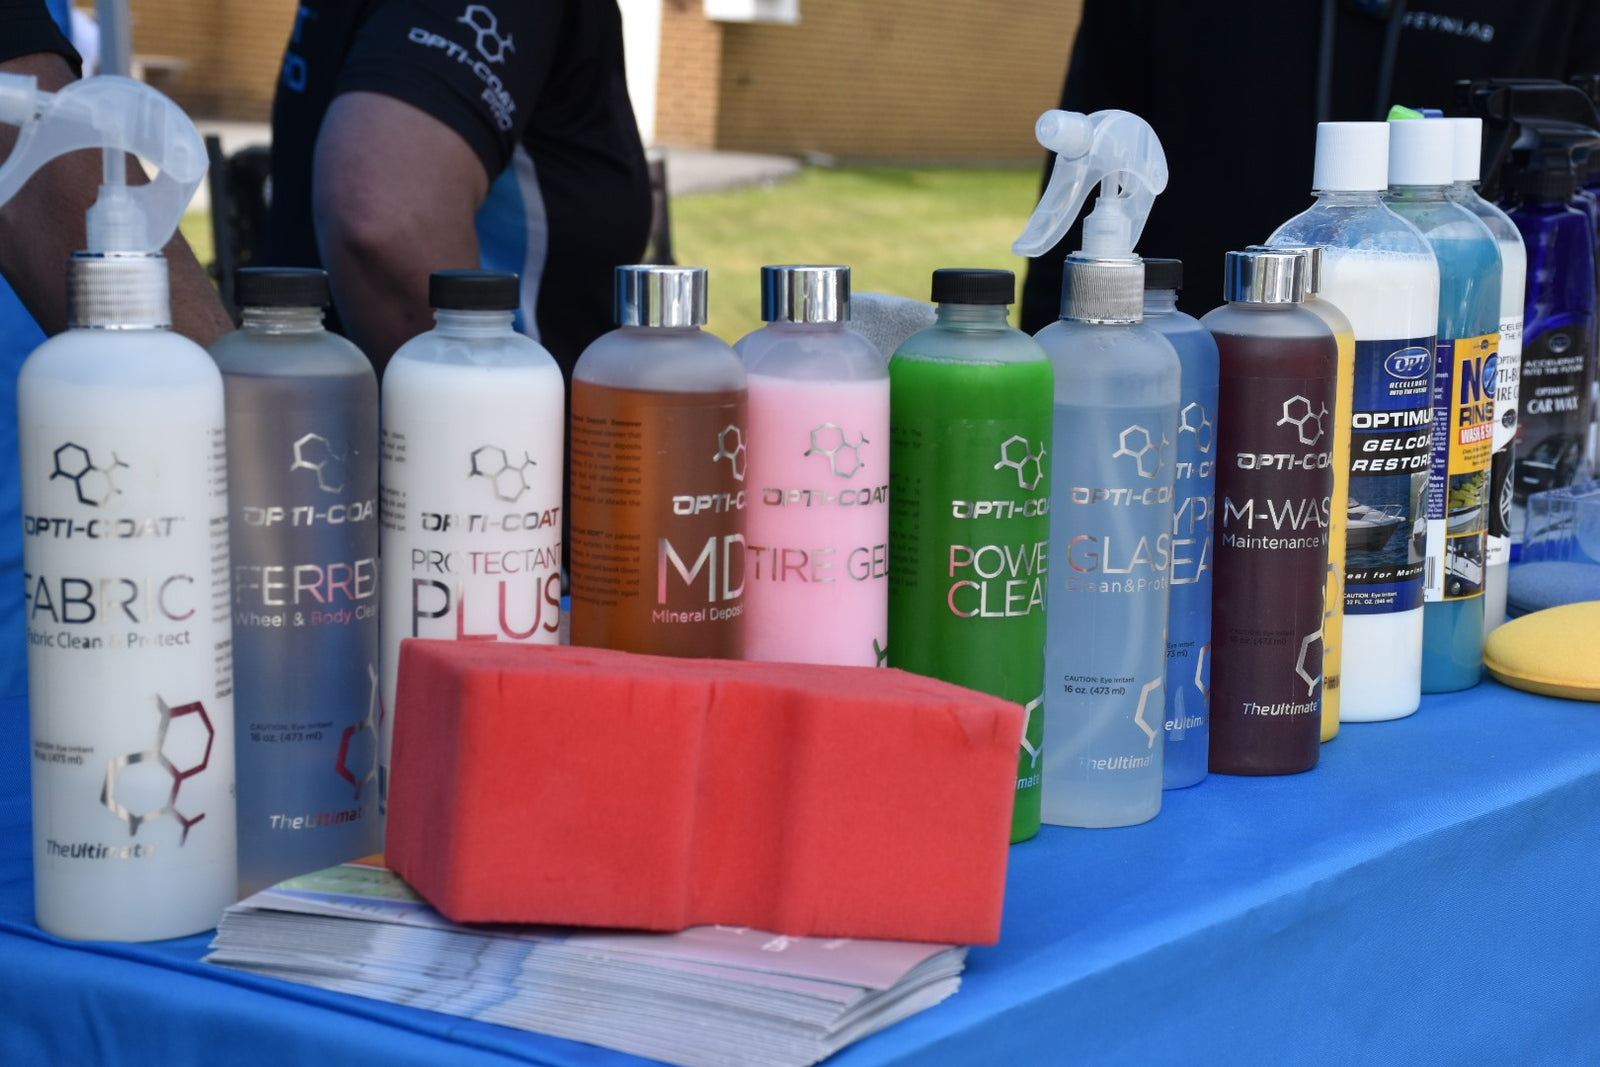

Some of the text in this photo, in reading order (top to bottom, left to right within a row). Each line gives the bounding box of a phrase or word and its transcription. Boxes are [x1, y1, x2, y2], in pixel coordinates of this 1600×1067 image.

[1461, 352, 1498, 405] NO
[1459, 402, 1494, 428] RINS
[1527, 396, 1579, 414] CAR WAX
[1237, 452, 1333, 470] OPTI-COA
[1352, 452, 1431, 471] RESTORE
[672, 490, 747, 515] OPTI-C
[763, 485, 888, 507] OPTI-COAT
[421, 508, 560, 532] OPTI-COAT
[1223, 496, 1330, 530] M-WAS
[1222, 533, 1319, 549] Maintenance
[412, 543, 561, 575] PROTECTANT
[747, 543, 889, 583] TIRE GEL
[949, 541, 1048, 579] POWE
[1067, 533, 1169, 573] GLAS
[1344, 571, 1368, 579] eal
[1373, 571, 1392, 579] for
[412, 572, 561, 640] PLUS
[948, 577, 1047, 618] CLEA
[235, 612, 285, 627] Wheel
[293, 612, 305, 627] &
[312, 608, 351, 625] Body
[652, 608, 706, 624] Mineral
[57, 631, 103, 650] Clean
[126, 630, 191, 648] Protect
[1064, 675, 1098, 683] CAUTION:
[1064, 685, 1126, 696] 16 oz. (473 ml)
[1242, 701, 1318, 716] TheUltimate
[280, 732, 304, 743] (473
